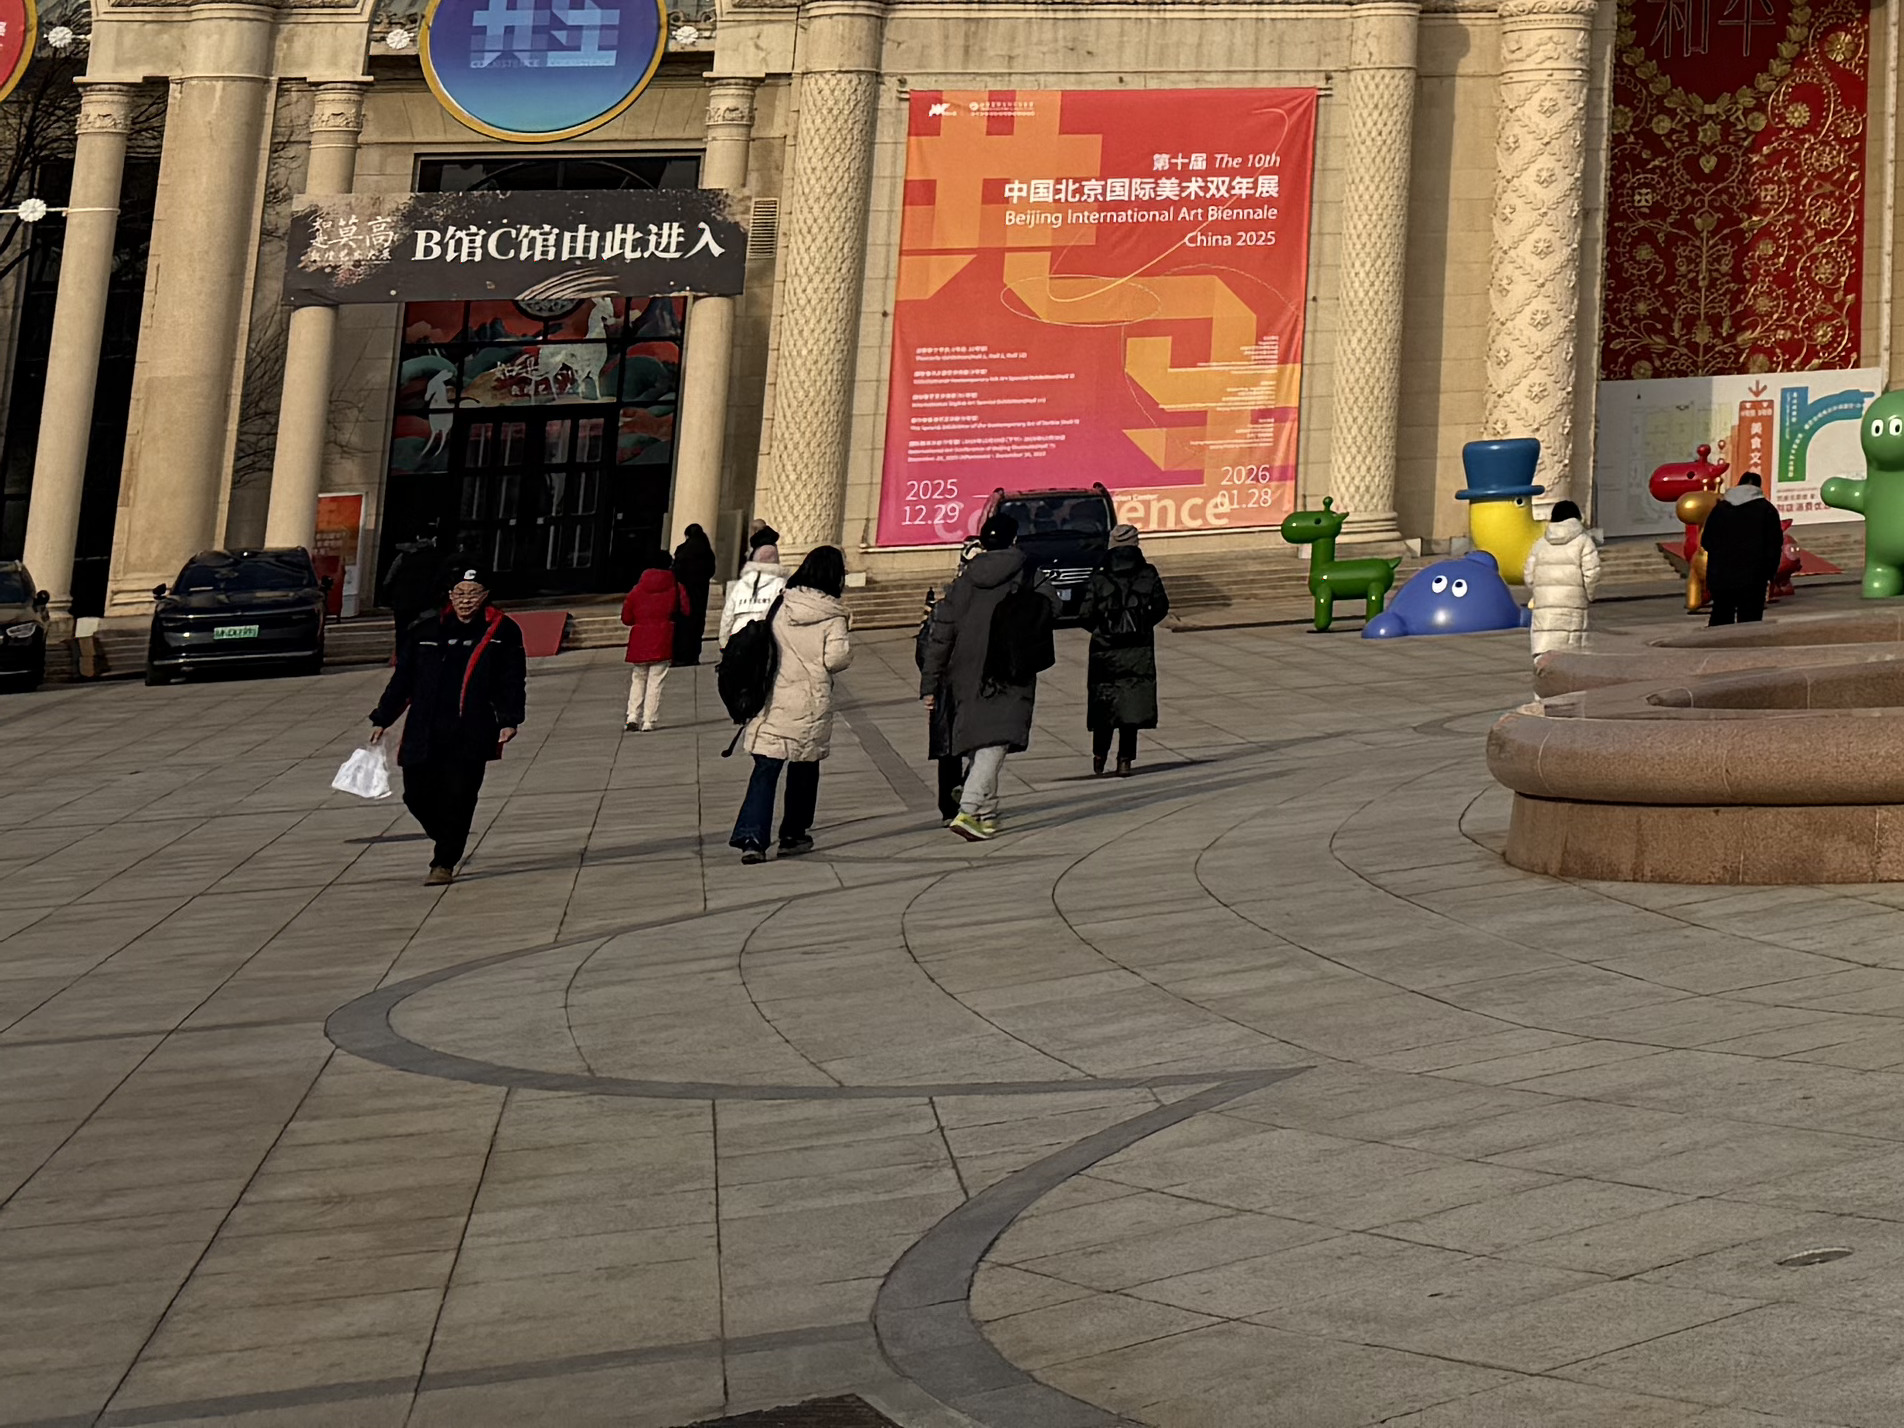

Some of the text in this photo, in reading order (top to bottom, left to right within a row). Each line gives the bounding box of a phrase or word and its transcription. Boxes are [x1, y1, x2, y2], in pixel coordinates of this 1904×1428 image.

[1152, 152, 1281, 171] 第十届 The 10th
[1003, 175, 1280, 204] 中国北京国际美术双年展
[1005, 204, 1278, 229] Beijing International Art Biennale
[411, 222, 726, 263] B馆C馆由此进入
[1185, 231, 1276, 248] China 2025
[1220, 464, 1271, 485] 2026
[905, 478, 959, 501] 2025
[1216, 487, 1272, 510] 01.28
[902, 503, 961, 526] 12.29
